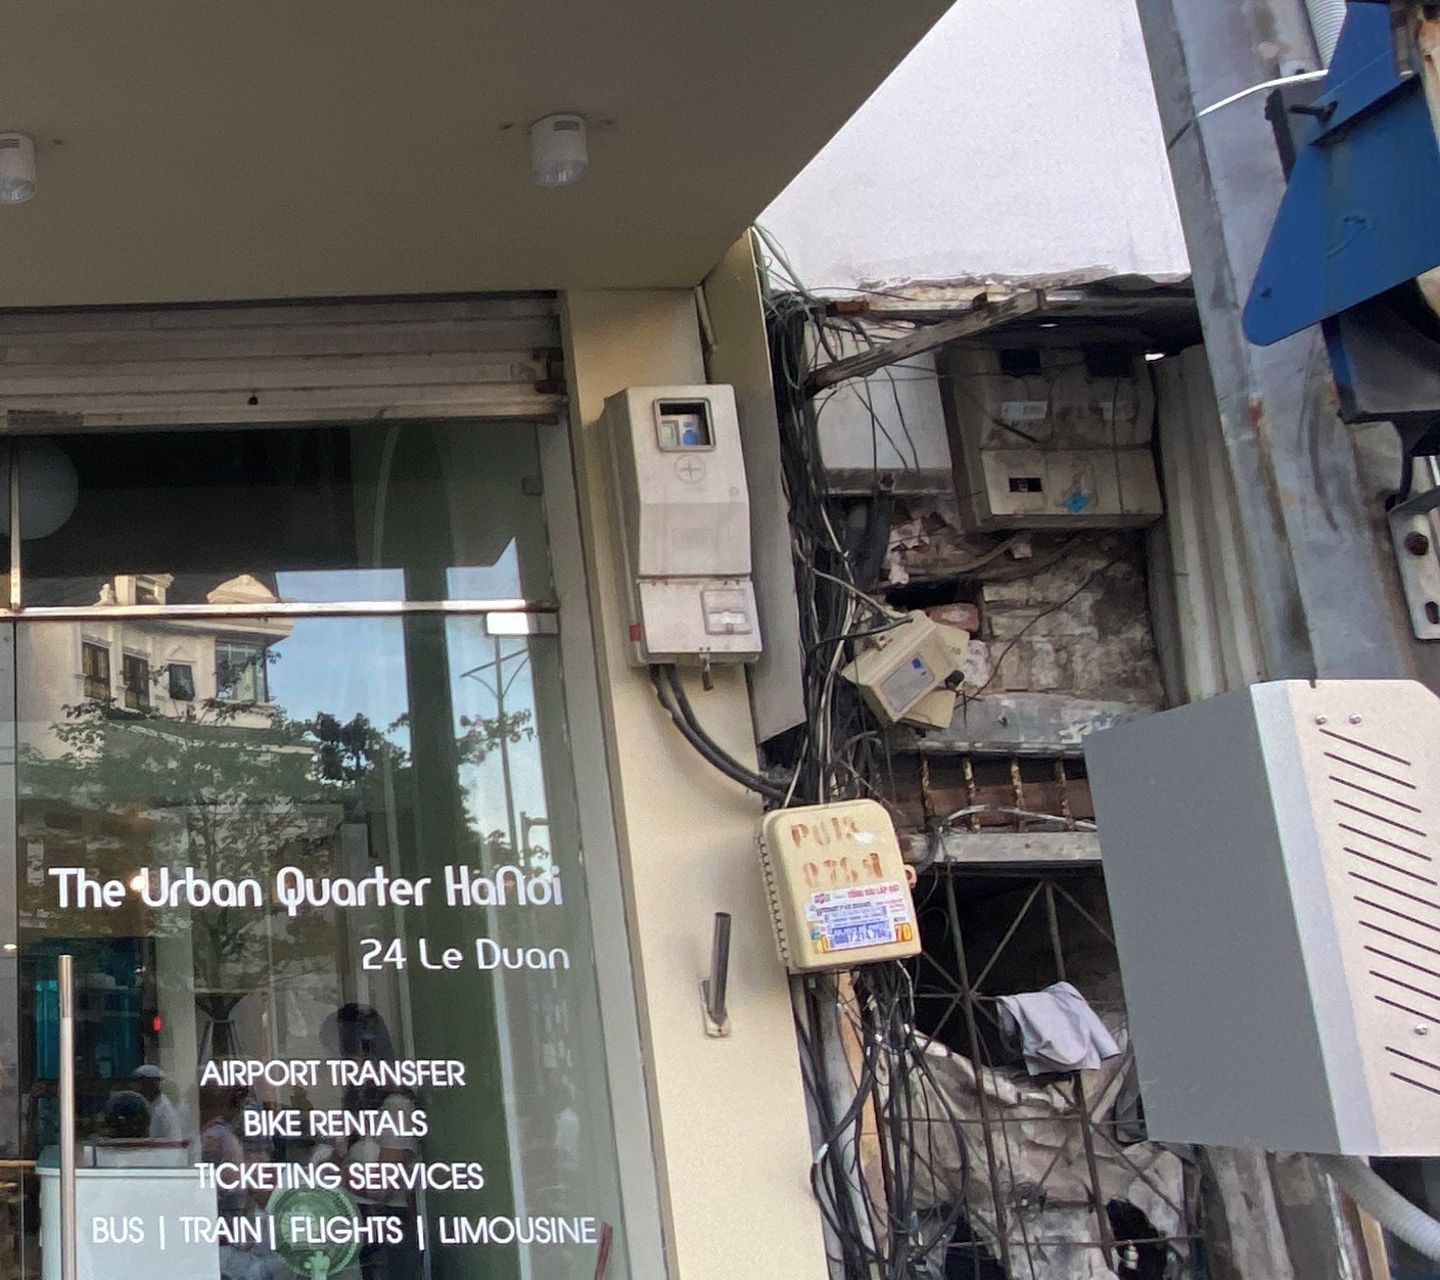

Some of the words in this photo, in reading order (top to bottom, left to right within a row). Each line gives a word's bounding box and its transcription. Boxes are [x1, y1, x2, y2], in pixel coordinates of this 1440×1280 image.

[48, 867, 126, 908] The
[140, 866, 263, 909] Urban
[276, 865, 433, 916] Quarter
[360, 937, 407, 970] 24
[418, 937, 464, 970] Le
[476, 937, 571, 971] Duan
[200, 1059, 325, 1088] AIRPORT
[326, 1059, 466, 1088] TRANSFER
[242, 1109, 303, 1138] BIKE
[310, 1109, 429, 1138] RENTALS
[194, 1161, 343, 1191] TICKETING
[348, 1161, 484, 1191] SERVICES
[91, 1215, 145, 1245] BUS
[179, 1215, 268, 1245] TRAIN
[289, 1215, 404, 1245] FLIGHTS
[438, 1215, 597, 1245] LIMOUSINE
